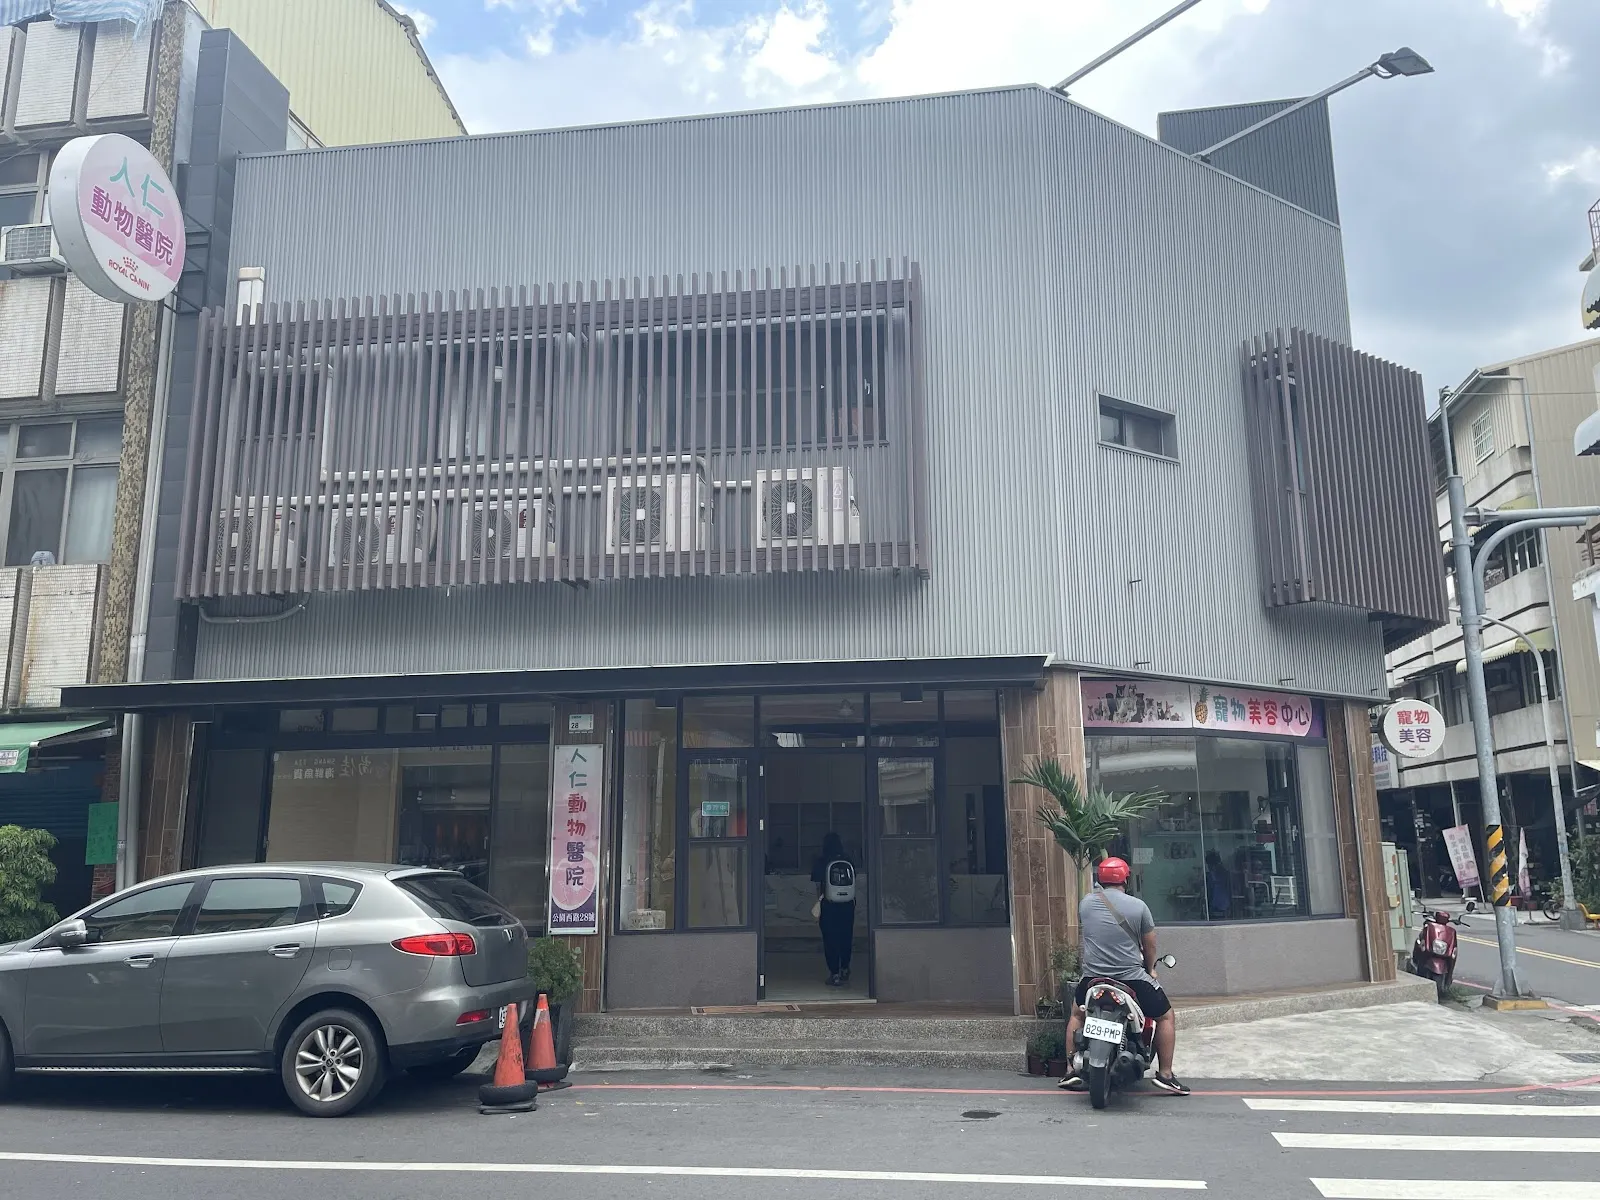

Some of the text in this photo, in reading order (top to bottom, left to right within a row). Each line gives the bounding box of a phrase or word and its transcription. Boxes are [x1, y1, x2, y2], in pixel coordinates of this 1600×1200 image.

[109, 156, 165, 218] 人仁
[91, 184, 174, 266] 動物醫院
[108, 259, 150, 292] ROYAL CANIN
[1212, 694, 1311, 727] 寵物美容中心
[1396, 709, 1431, 726] 寵物
[1398, 728, 1432, 744] 美容
[565, 747, 588, 887] 人仁動物醫院
[1085, 1024, 1121, 1039] 829-PMP
